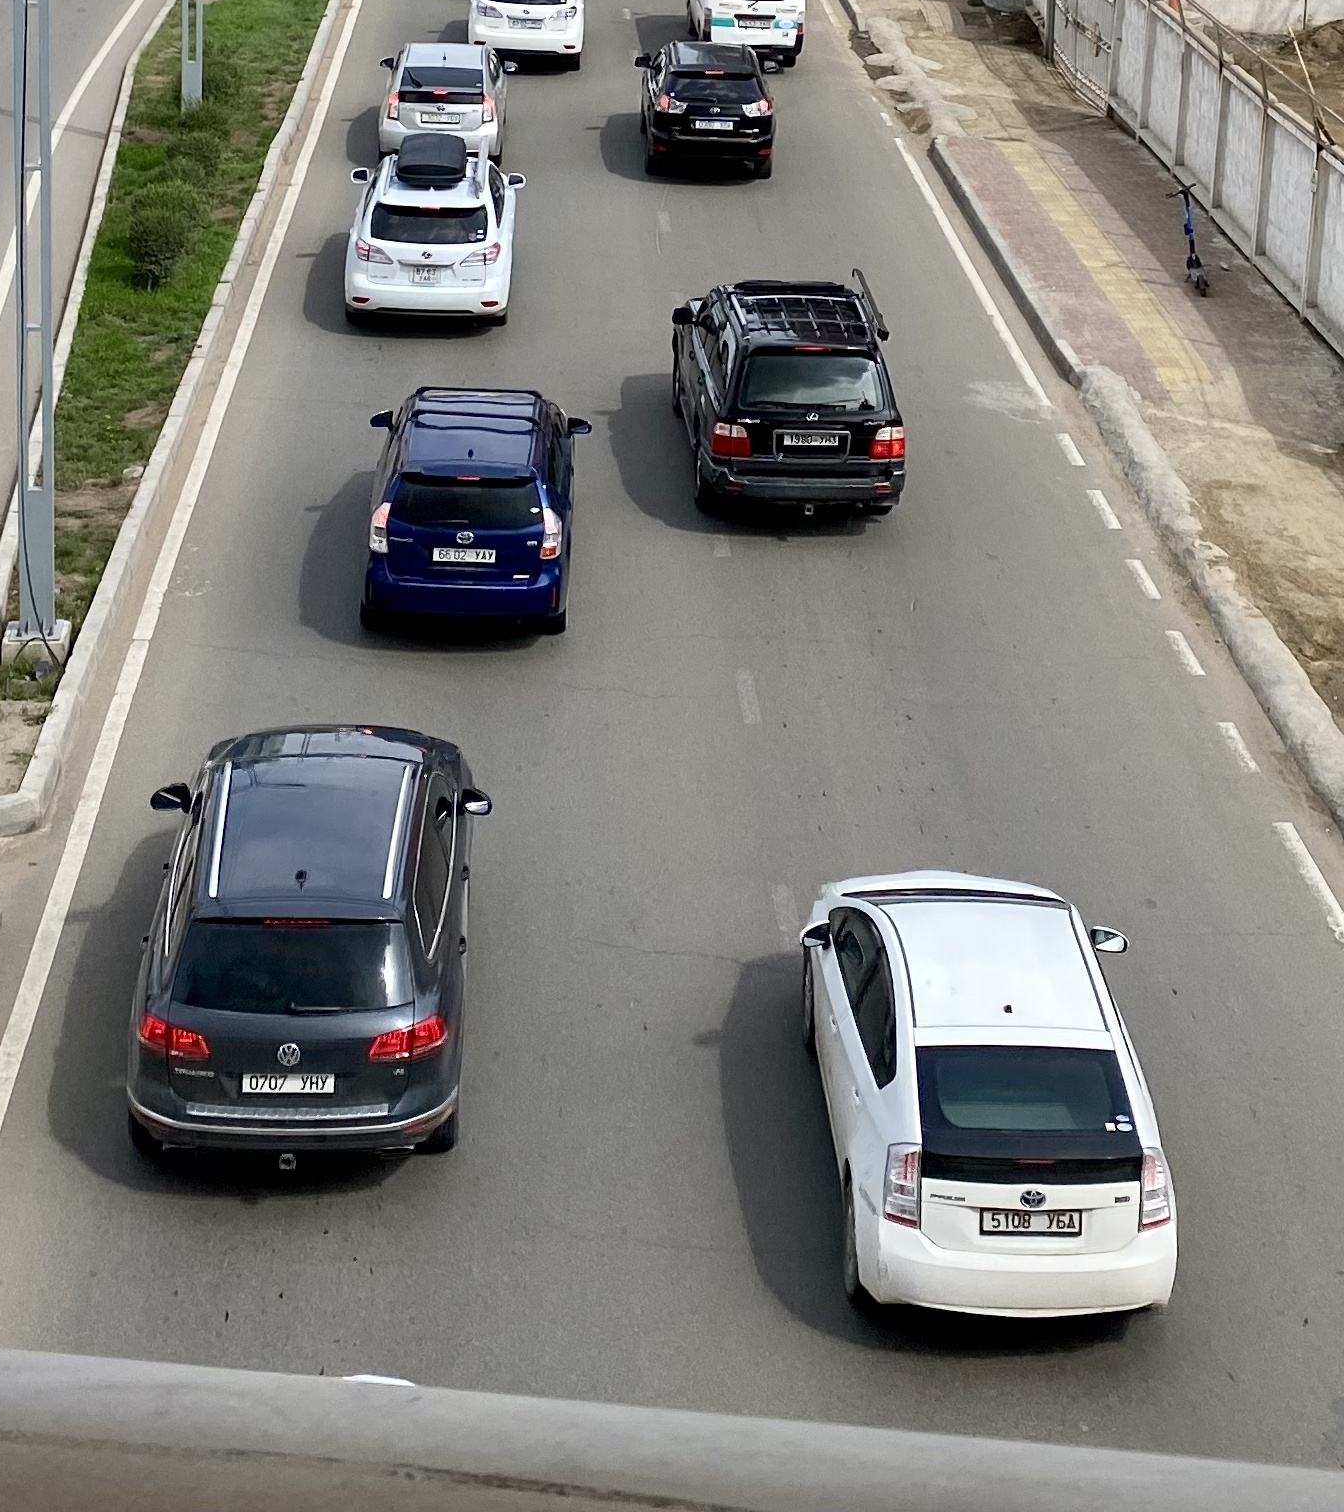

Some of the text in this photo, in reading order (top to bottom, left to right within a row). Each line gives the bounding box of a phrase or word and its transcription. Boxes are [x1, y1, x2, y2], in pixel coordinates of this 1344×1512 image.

[248, 1074, 328, 1092] 0707 УНУ
[991, 1212, 1031, 1230] 5108
